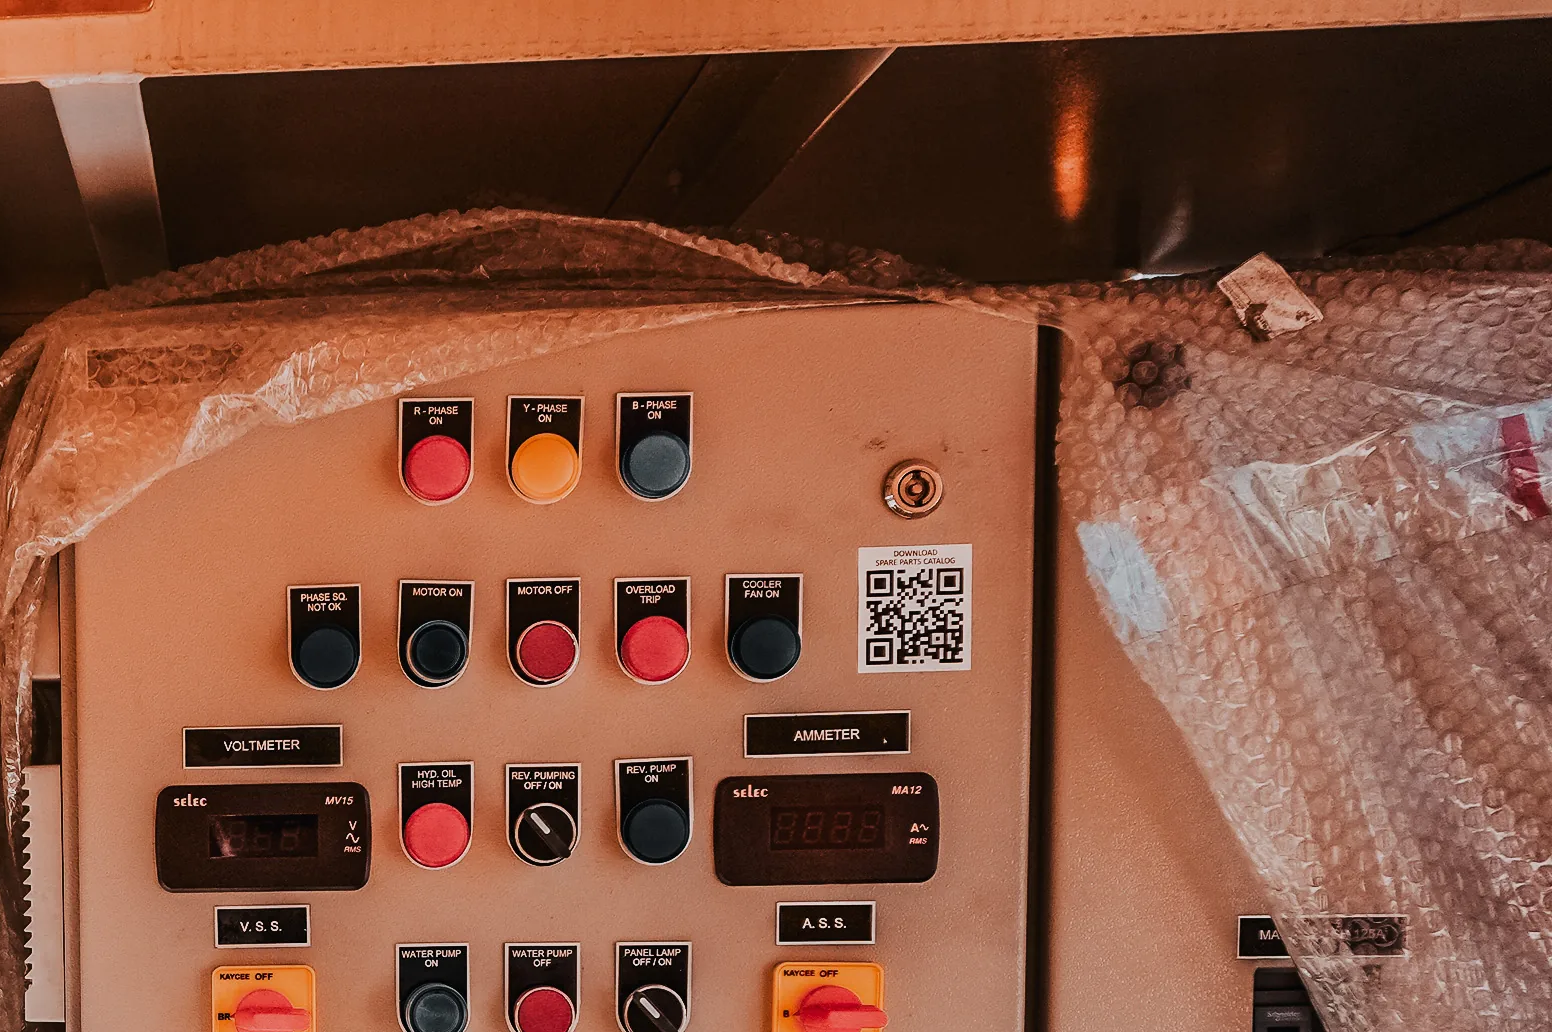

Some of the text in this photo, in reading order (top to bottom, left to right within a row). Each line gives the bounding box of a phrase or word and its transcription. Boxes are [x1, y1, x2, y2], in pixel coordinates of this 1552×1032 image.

[524, 404, 567, 412] Y PHASE
[633, 400, 676, 409] B PHASE
[414, 406, 458, 415] R PHASE
[538, 414, 552, 422] ON
[648, 411, 661, 419] ON
[429, 417, 442, 425] ON
[894, 549, 937, 557] DOWNLOAD
[413, 588, 462, 596] MOTOR ON
[518, 585, 572, 595] MOTOR OFF
[626, 585, 675, 594] OVERLOAD
[301, 593, 347, 602] PHASE SQ.
[745, 590, 779, 598] FAN ON
[640, 595, 661, 603] TRIP
[308, 602, 341, 611] NOT OK
[794, 729, 860, 741] AMMETER
[224, 740, 300, 751] VOLTMETER
[627, 764, 676, 774] REV. PUMP
[418, 770, 456, 778] HYD. OIL
[512, 771, 575, 780] REV. PUMPING
[645, 775, 658, 783] ON
[412, 779, 462, 788] HIGH TEMP
[549, 781, 562, 789] ON
[892, 786, 922, 794] MA12
[325, 797, 353, 805] MV15
[349, 821, 357, 830] V
[402, 950, 433, 958] WATER
[425, 959, 438, 967] ON
[533, 959, 551, 967] OFF
[633, 958, 672, 966] OFF ON
[783, 1010, 790, 1018] B
